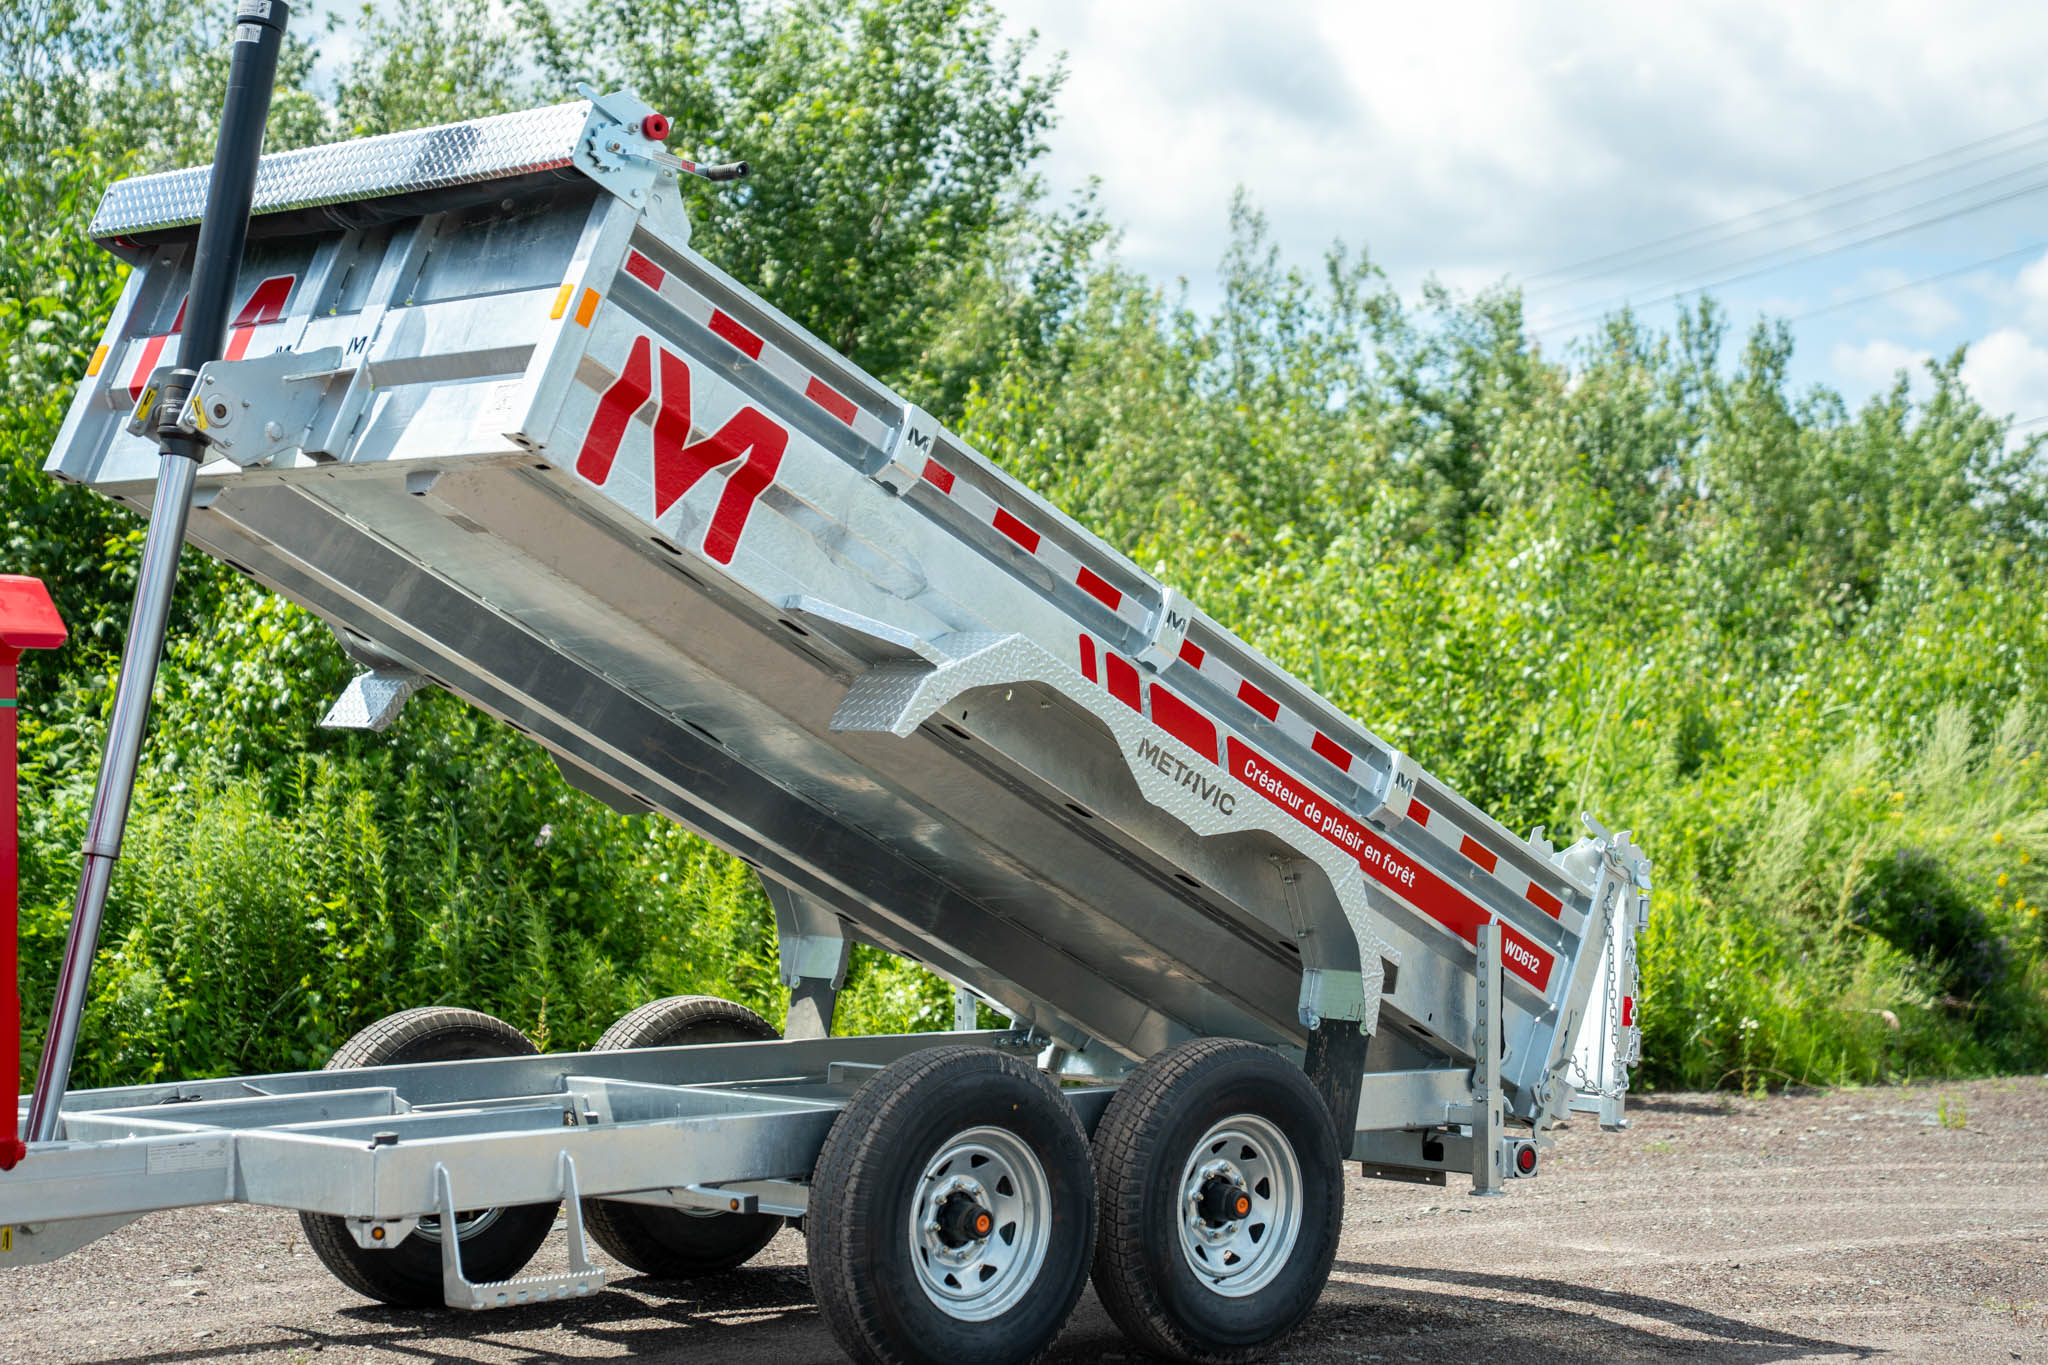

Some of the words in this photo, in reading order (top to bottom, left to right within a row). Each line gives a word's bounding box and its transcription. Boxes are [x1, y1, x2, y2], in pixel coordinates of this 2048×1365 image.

[575, 334, 790, 567] M
[1137, 737, 1236, 816] METAVIC
[1243, 759, 1304, 811] Créateur
[1304, 801, 1322, 824] de
[1321, 817, 1365, 852] plaisir
[1364, 844, 1382, 866] en
[1382, 850, 1416, 888] forêt
[1504, 937, 1541, 974] WD612
